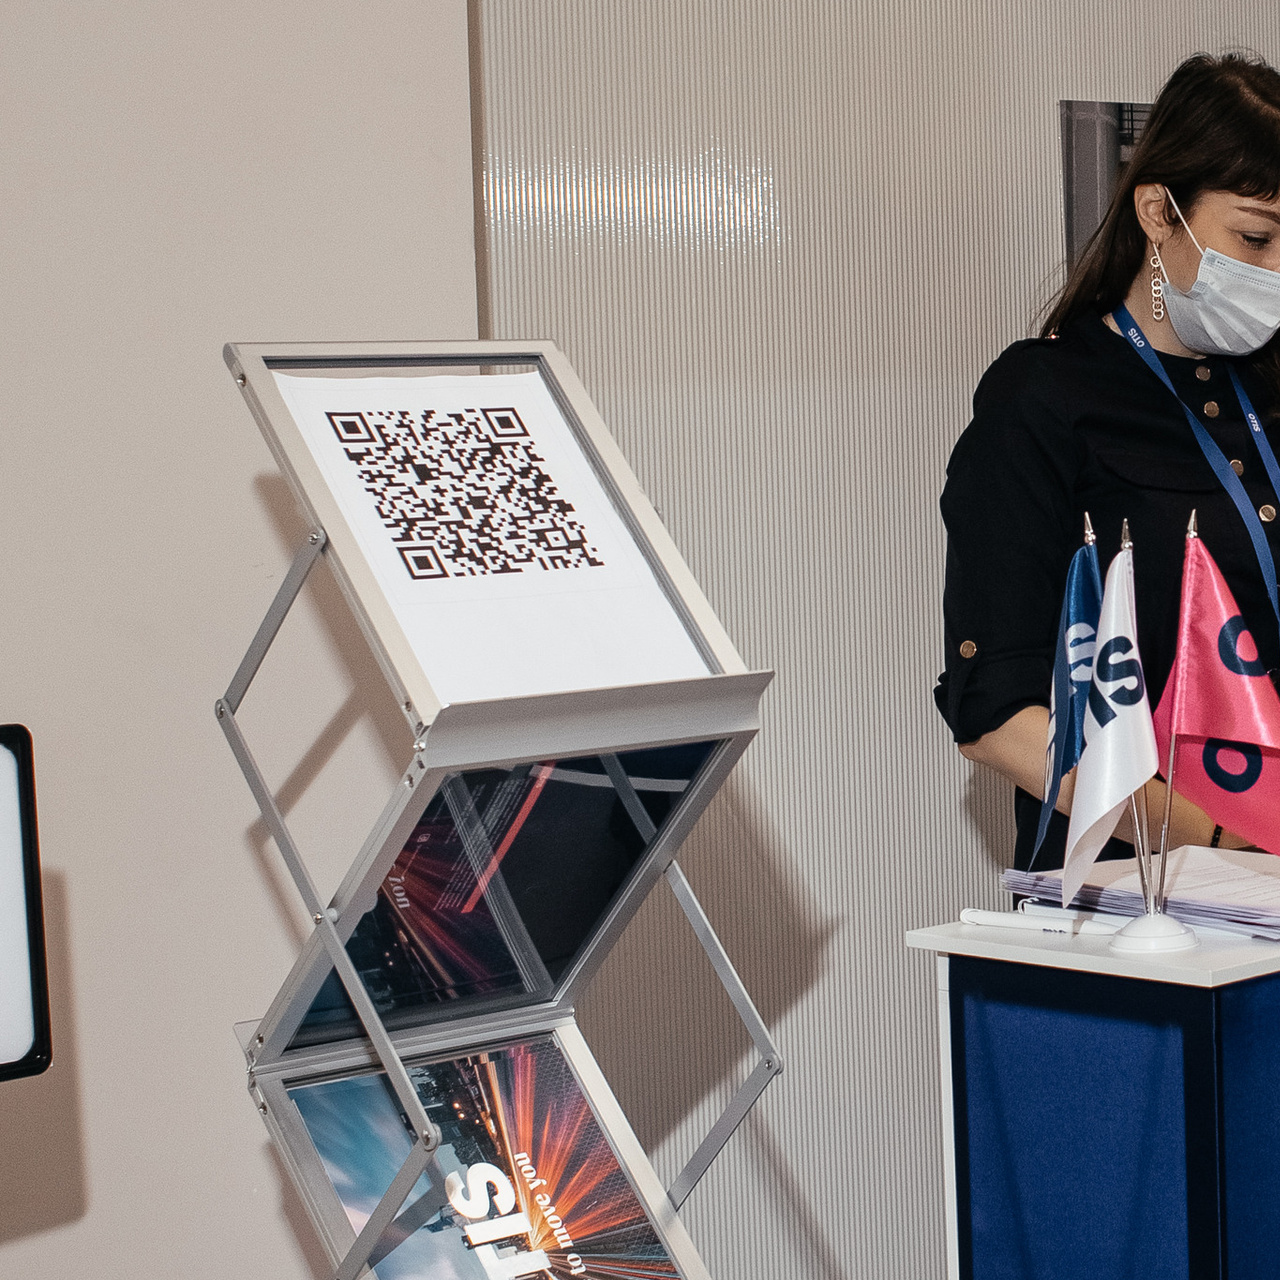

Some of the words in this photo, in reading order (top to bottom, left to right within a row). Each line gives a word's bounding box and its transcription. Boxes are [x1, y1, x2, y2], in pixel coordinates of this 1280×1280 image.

[1128, 327, 1145, 348] OTIS
[1247, 413, 1261, 433] OTIS
[513, 1151, 548, 1191] you
[534, 1193, 575, 1250] move
[566, 1252, 587, 1276] to
